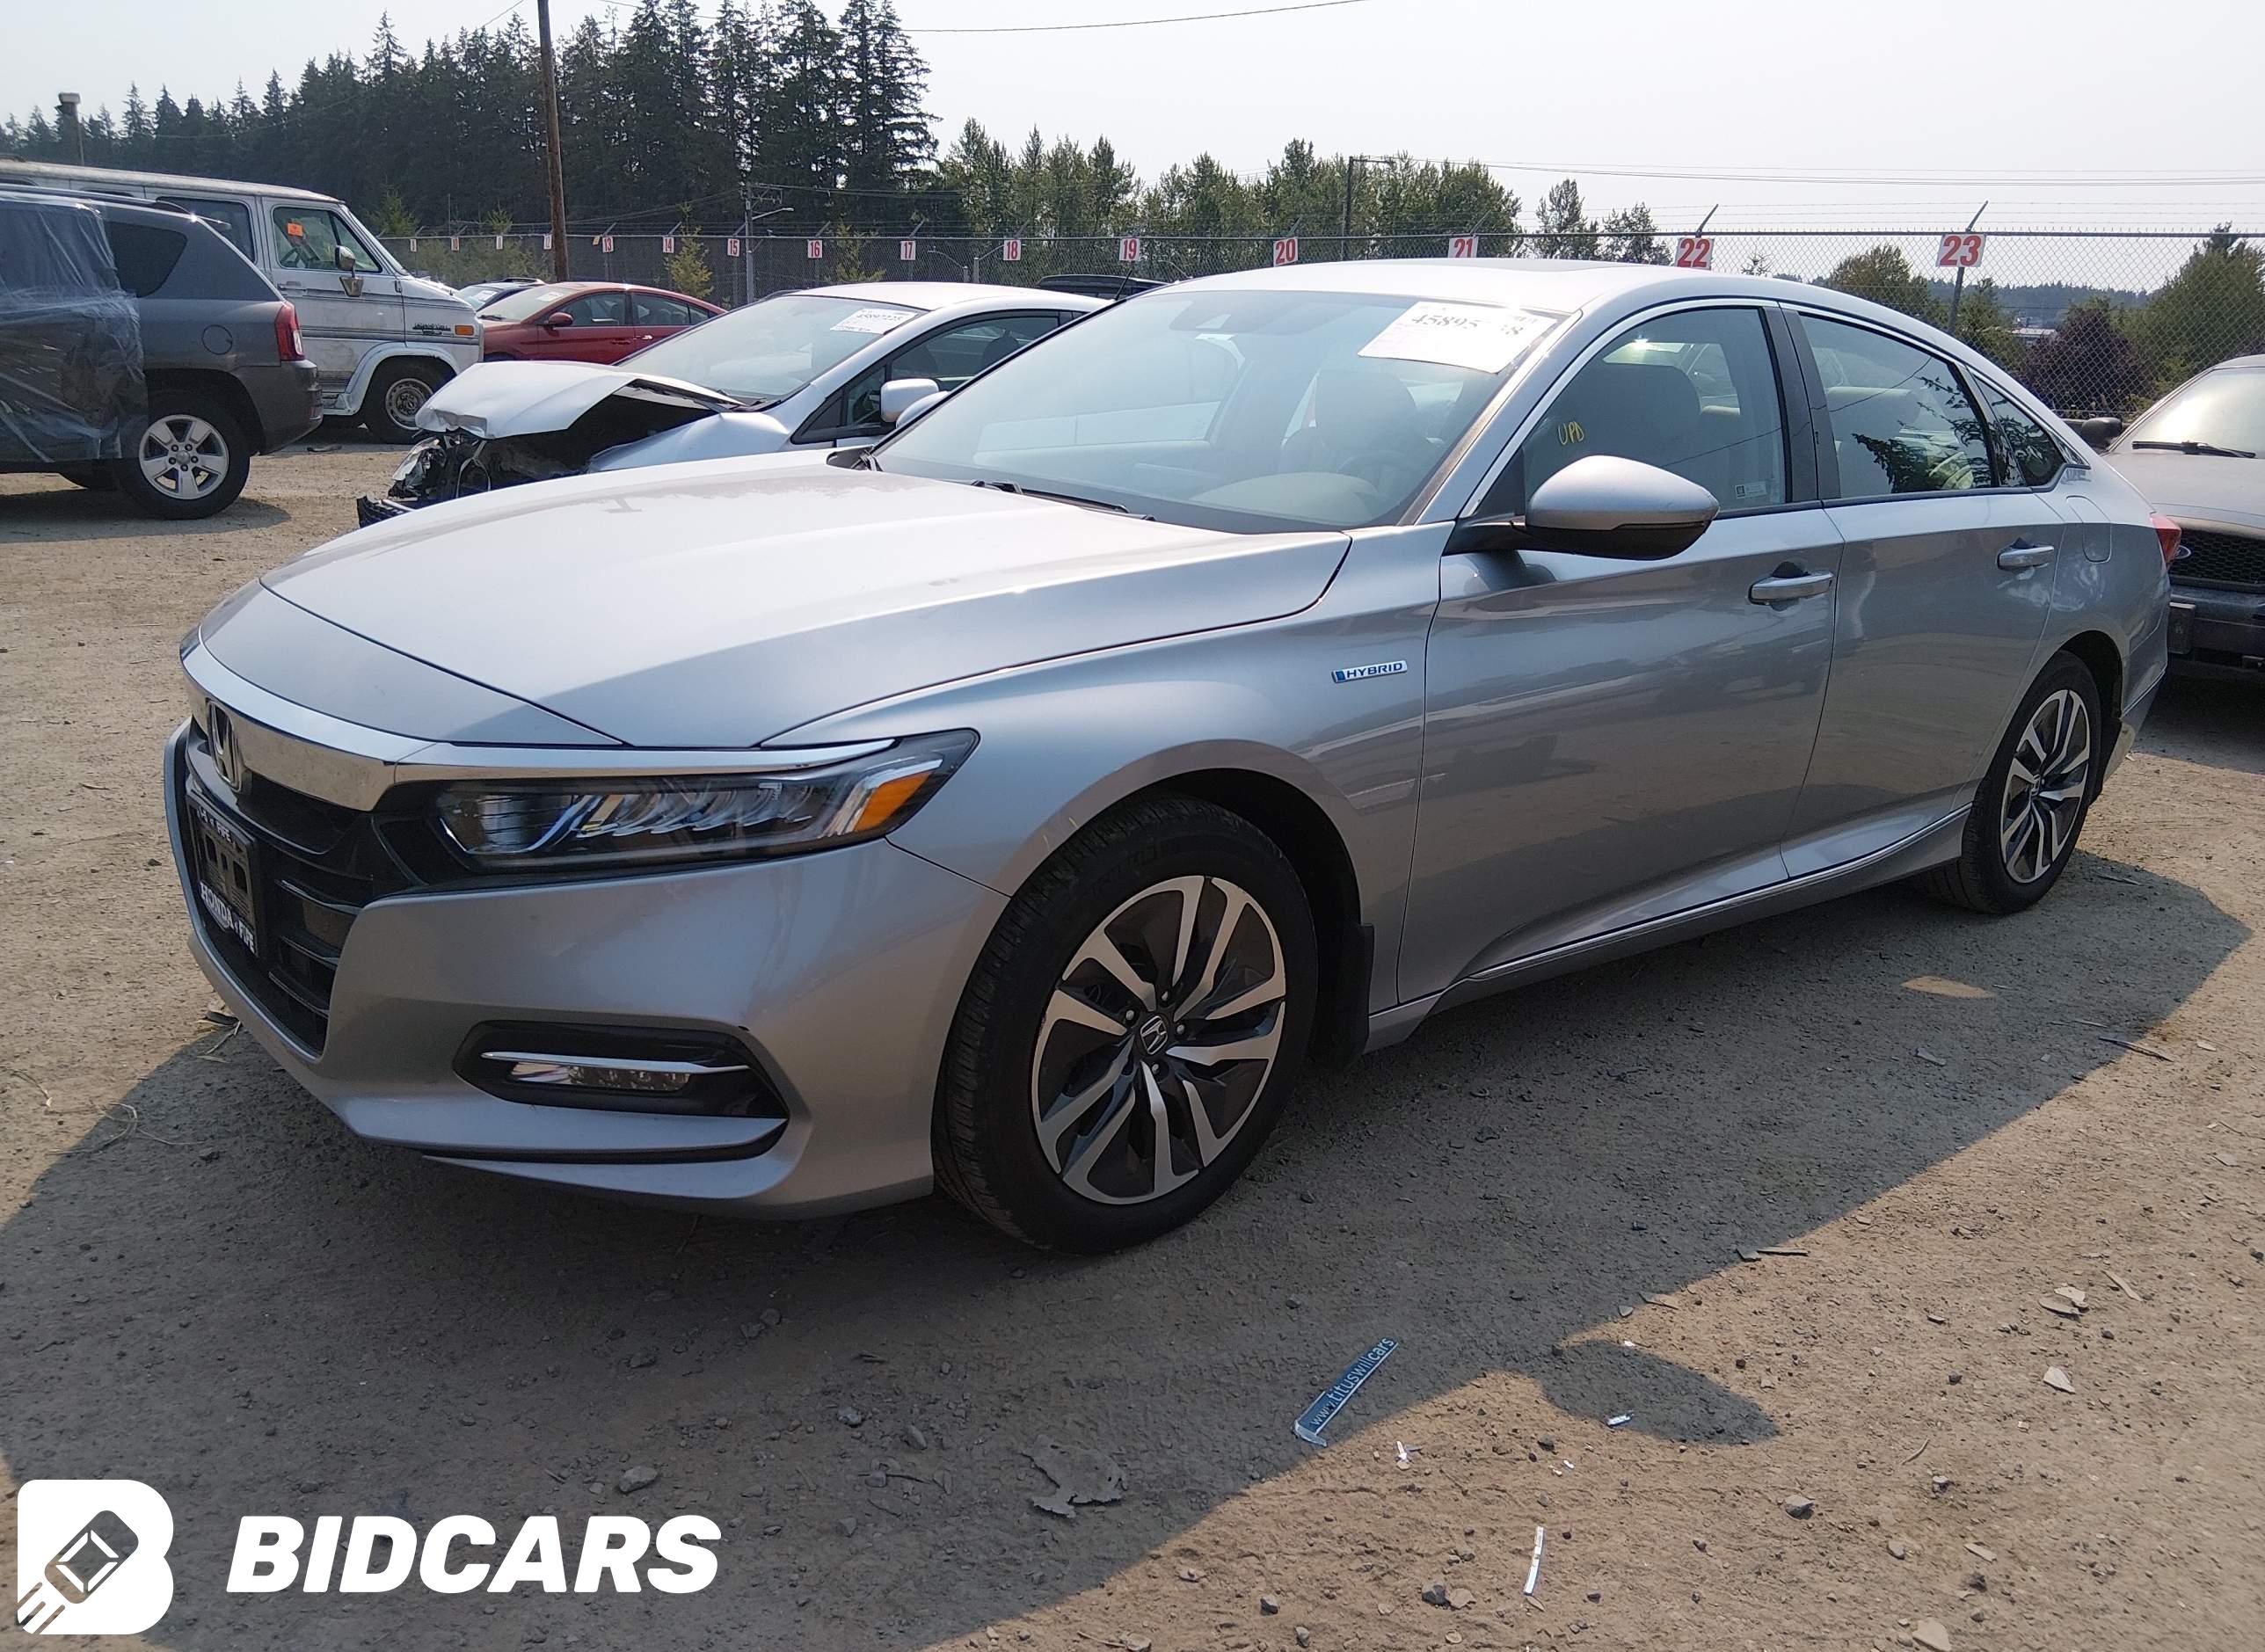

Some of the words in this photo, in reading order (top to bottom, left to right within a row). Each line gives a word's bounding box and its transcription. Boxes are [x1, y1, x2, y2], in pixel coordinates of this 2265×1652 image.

[604, 237, 612, 251] 13
[665, 237, 673, 251] 14
[730, 238, 738, 255] 15
[810, 240, 820, 258] 16
[904, 241, 914, 259] 17
[1006, 240, 1018, 260] 18
[1123, 239, 1137, 261] 19
[1275, 238, 1296, 264] 20
[1453, 238, 1475, 258] 21
[1677, 237, 1710, 267] 22
[1940, 233, 1982, 266] 23
[1346, 662, 1402, 679] HYBRID
[200, 880, 235, 930] HONDA
